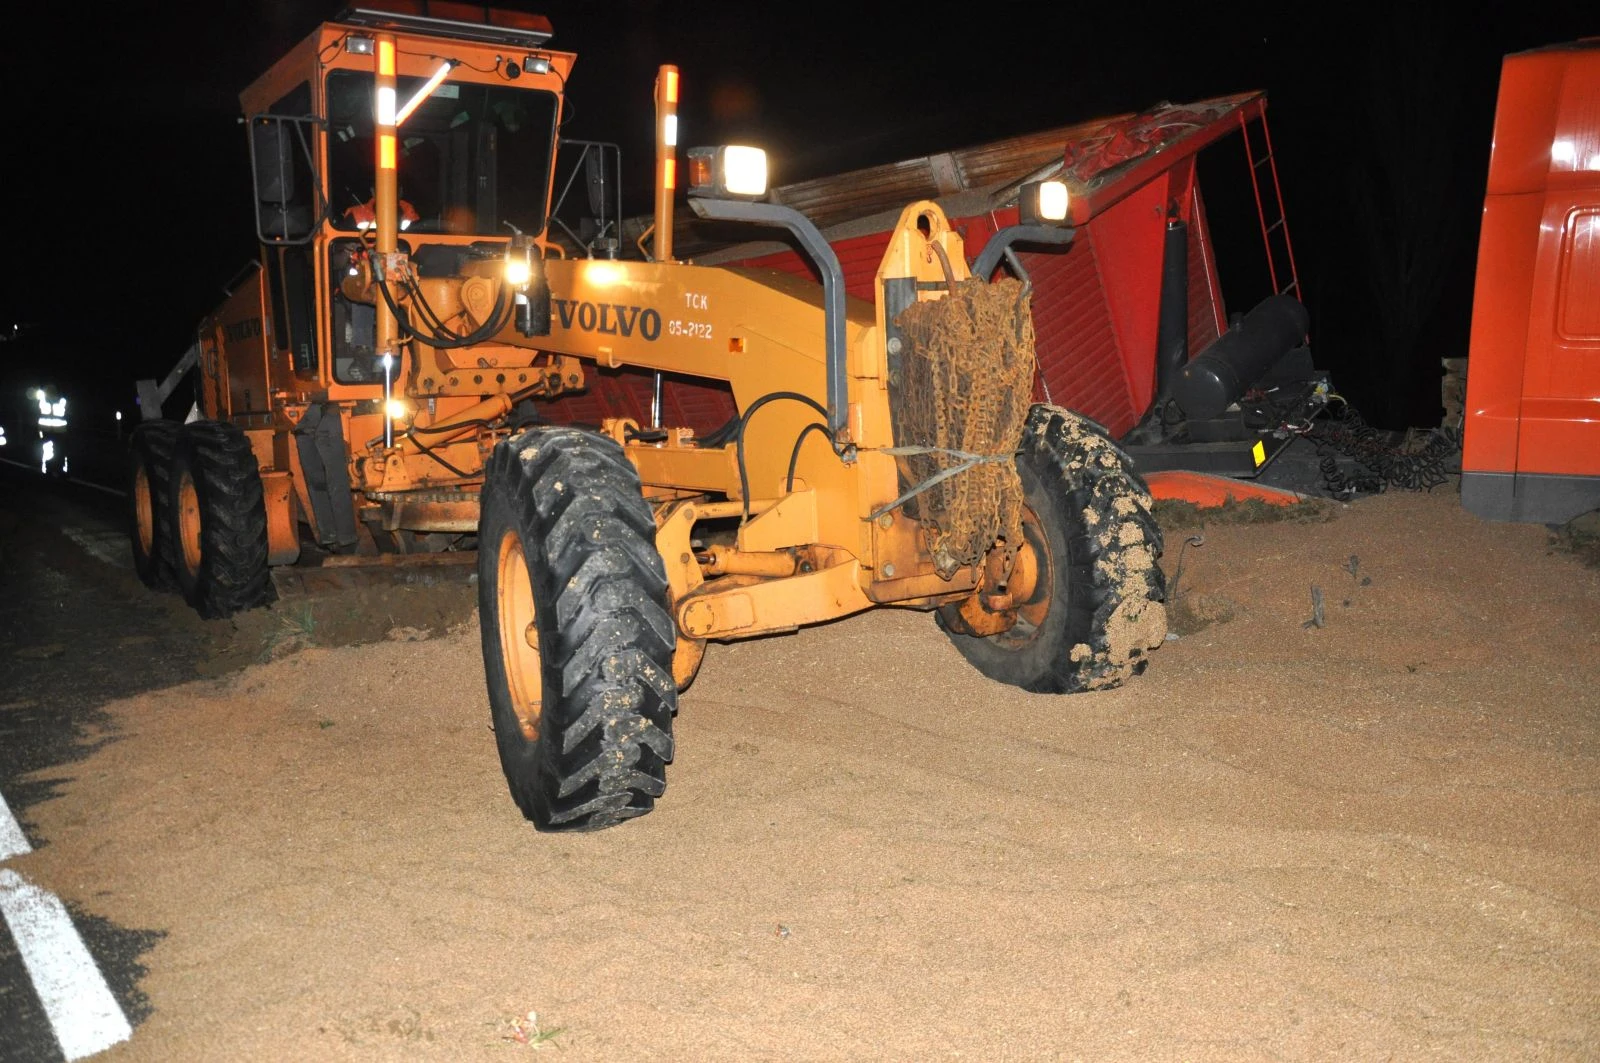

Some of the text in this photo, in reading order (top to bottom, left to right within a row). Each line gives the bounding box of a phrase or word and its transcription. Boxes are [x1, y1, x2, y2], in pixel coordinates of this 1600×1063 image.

[685, 293, 708, 310] TCK
[225, 317, 262, 343] VOLVO
[555, 299, 662, 342] VOLVO
